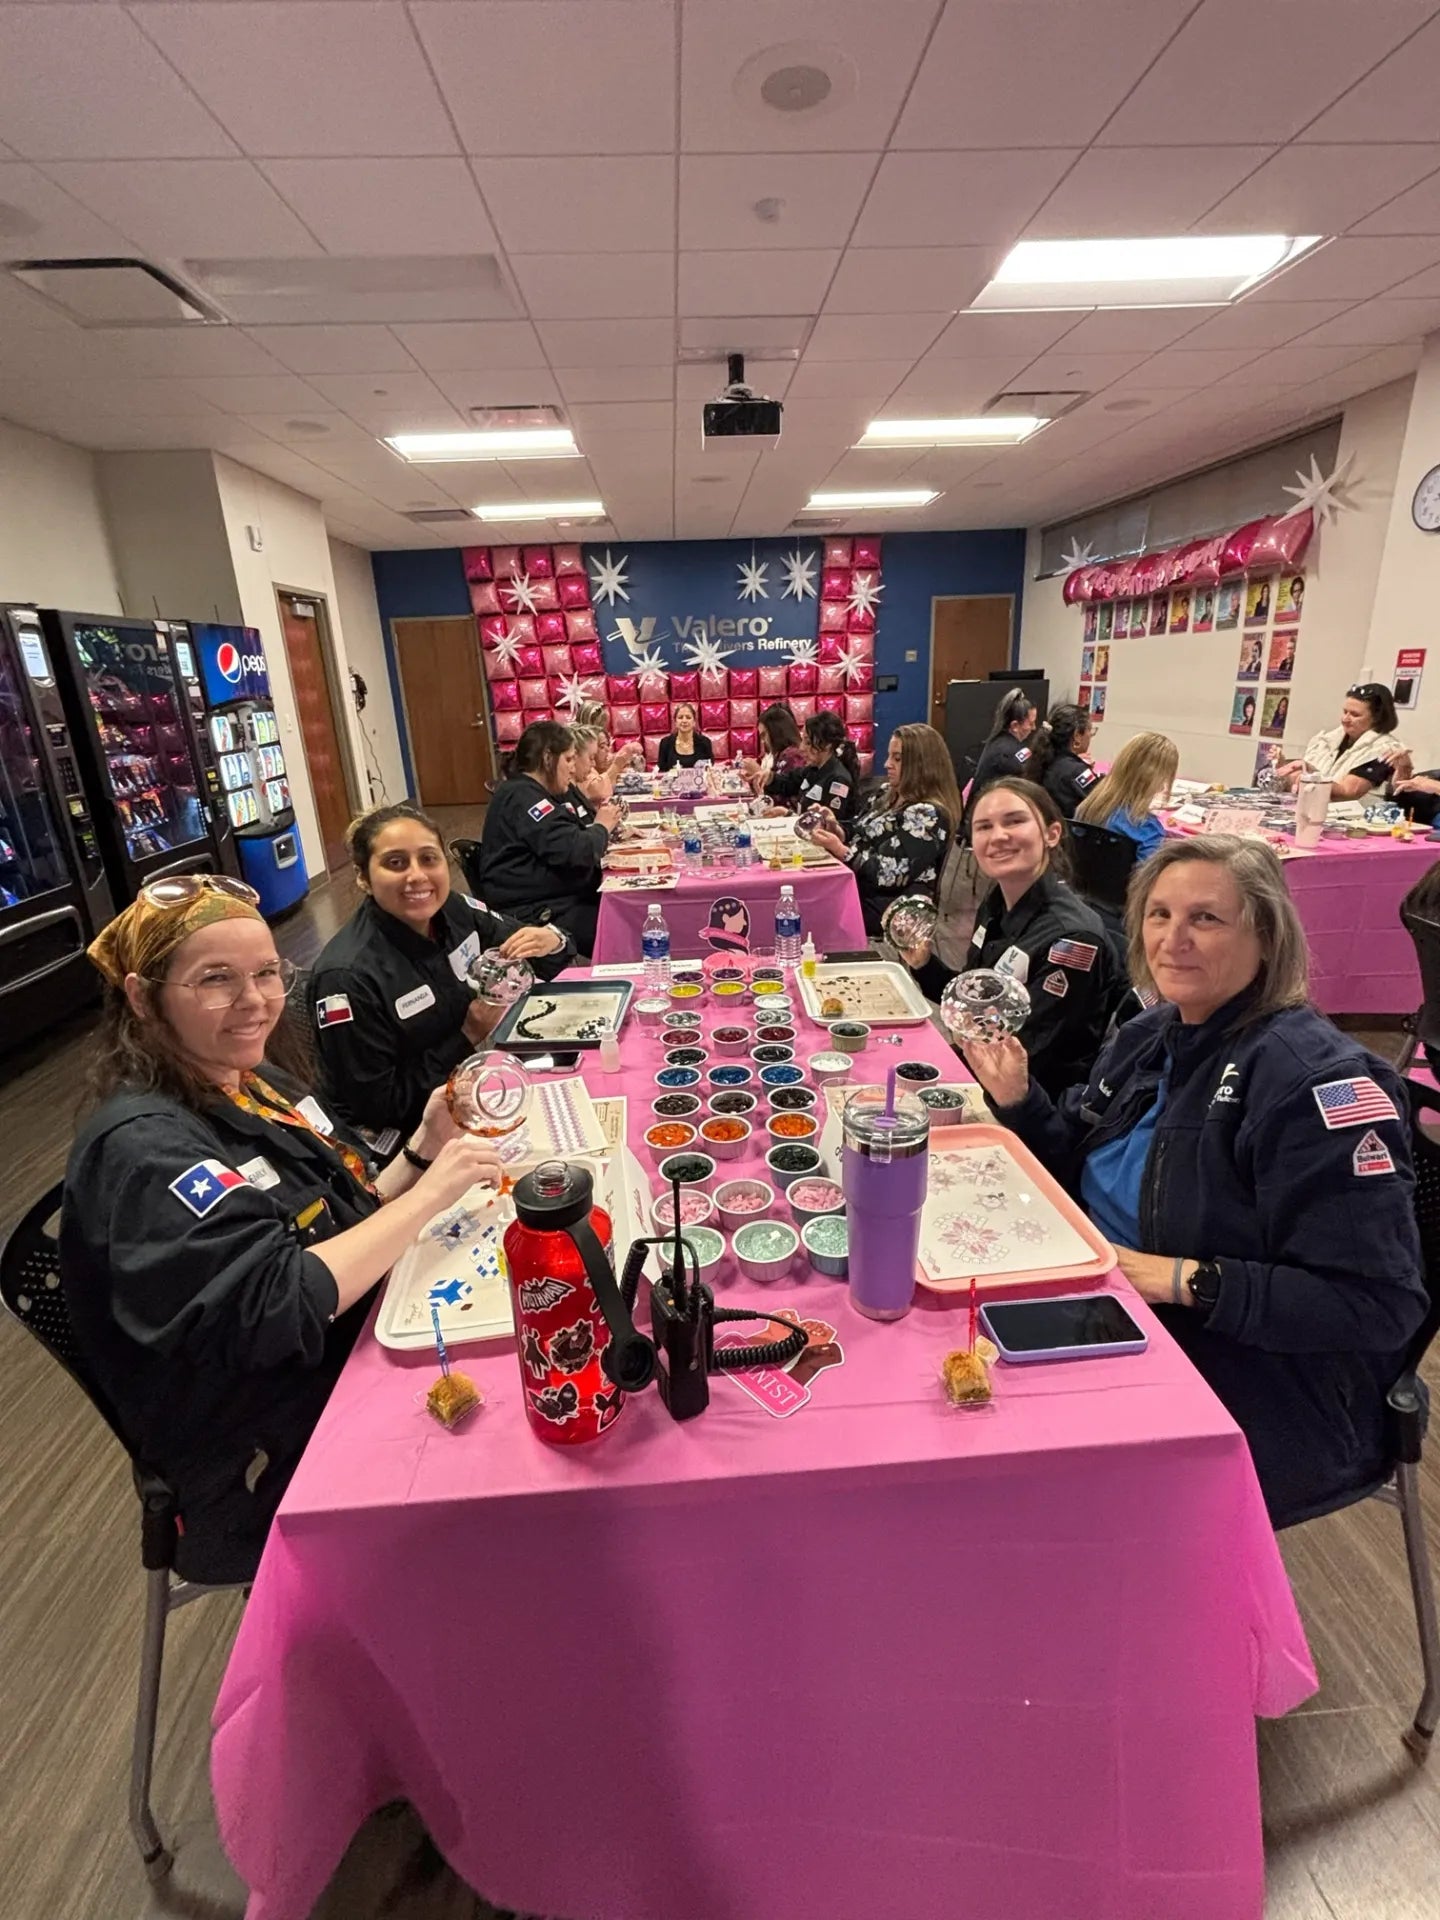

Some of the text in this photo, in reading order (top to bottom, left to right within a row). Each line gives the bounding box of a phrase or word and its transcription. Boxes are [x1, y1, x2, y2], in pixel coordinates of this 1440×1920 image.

[671, 614, 769, 638] Valero
[758, 637, 812, 651] Refinery
[242, 654, 266, 676] peps
[522, 1281, 568, 1308] MOTHMAN
